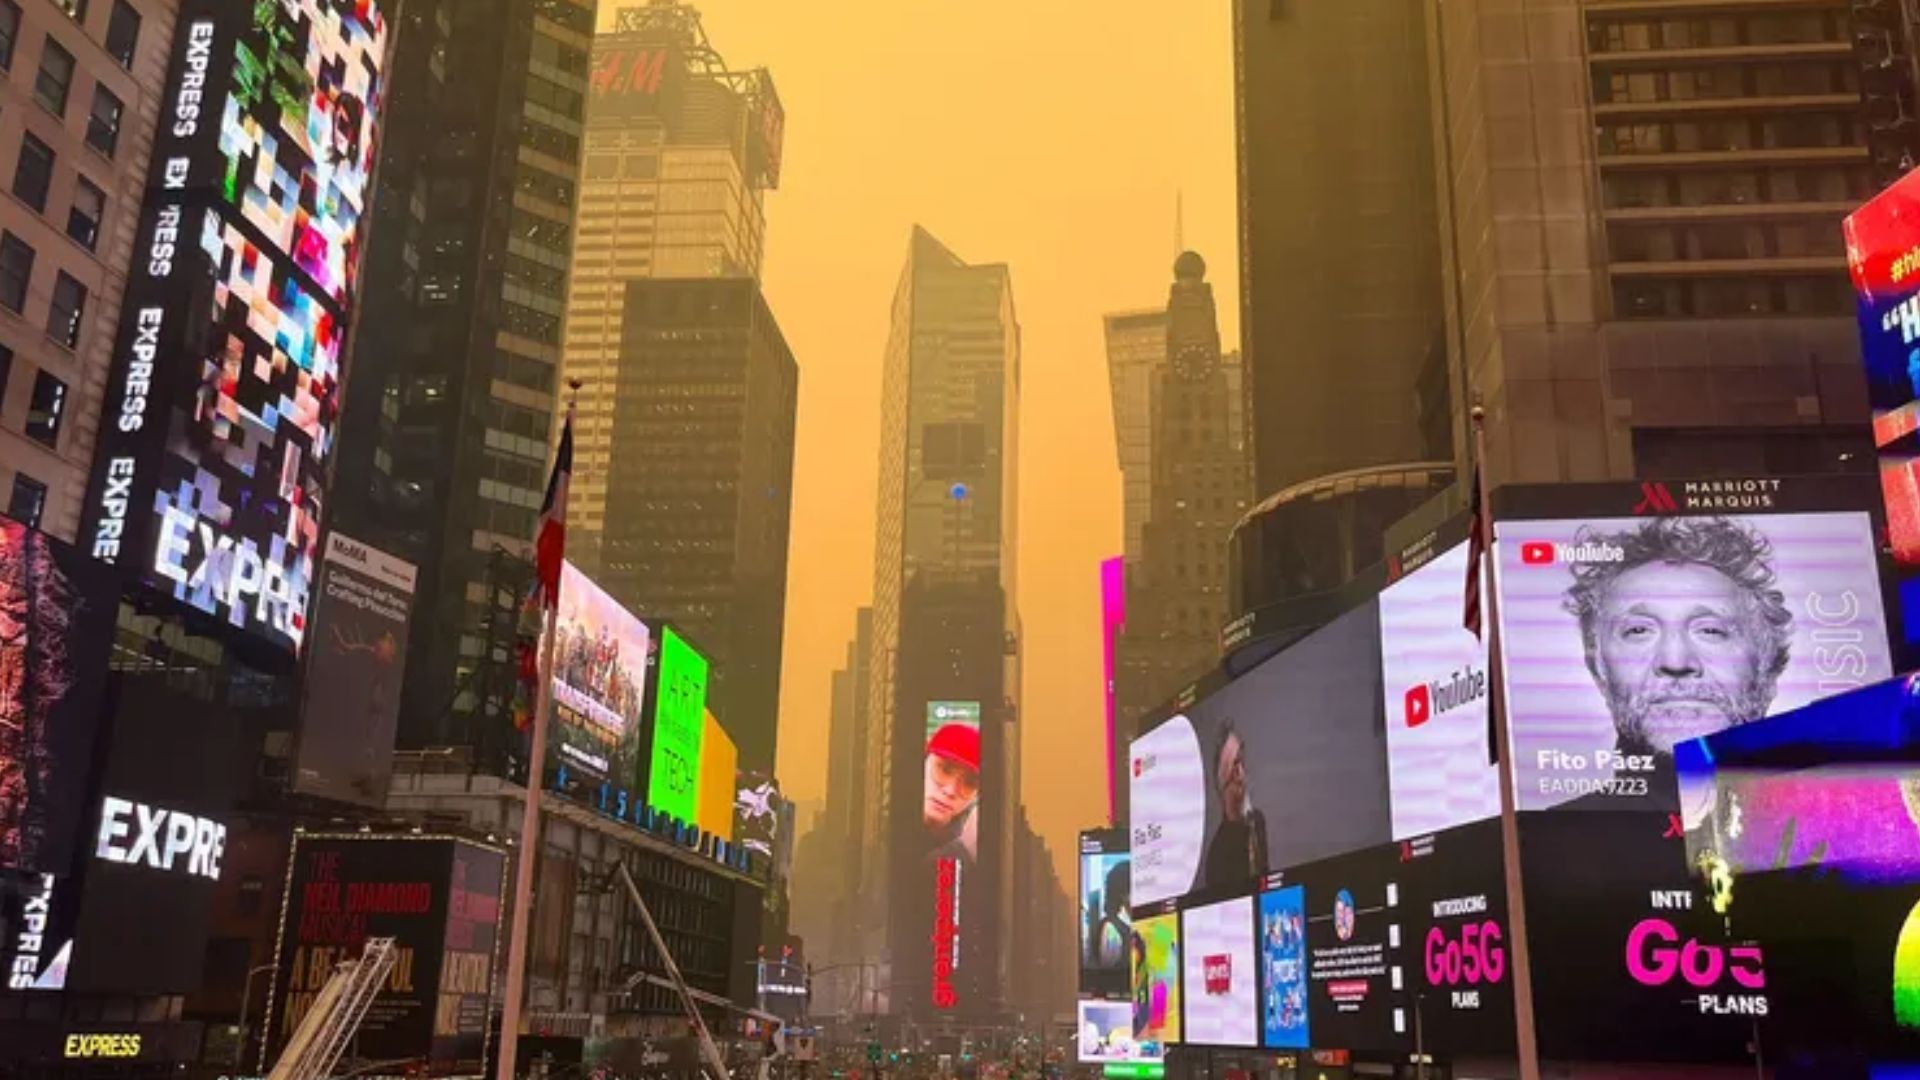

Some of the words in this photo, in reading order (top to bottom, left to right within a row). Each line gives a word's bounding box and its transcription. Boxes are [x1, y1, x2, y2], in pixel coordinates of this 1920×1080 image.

[173, 22, 214, 137] EXPRESS
[118, 308, 164, 432] EXPRESS
[1685, 480, 1780, 493] MARRIOTT
[92, 457, 136, 565] EXPRE
[1688, 496, 1772, 507] MARQUIS
[1555, 542, 1624, 562] YouTube
[1430, 665, 1484, 715] YouTube
[1537, 750, 1586, 770] Fito
[1595, 747, 1656, 771] Páez
[1425, 920, 1505, 986] Go5G
[1700, 995, 1767, 1015] PLANS
[64, 1033, 141, 1058] EXPRESS
